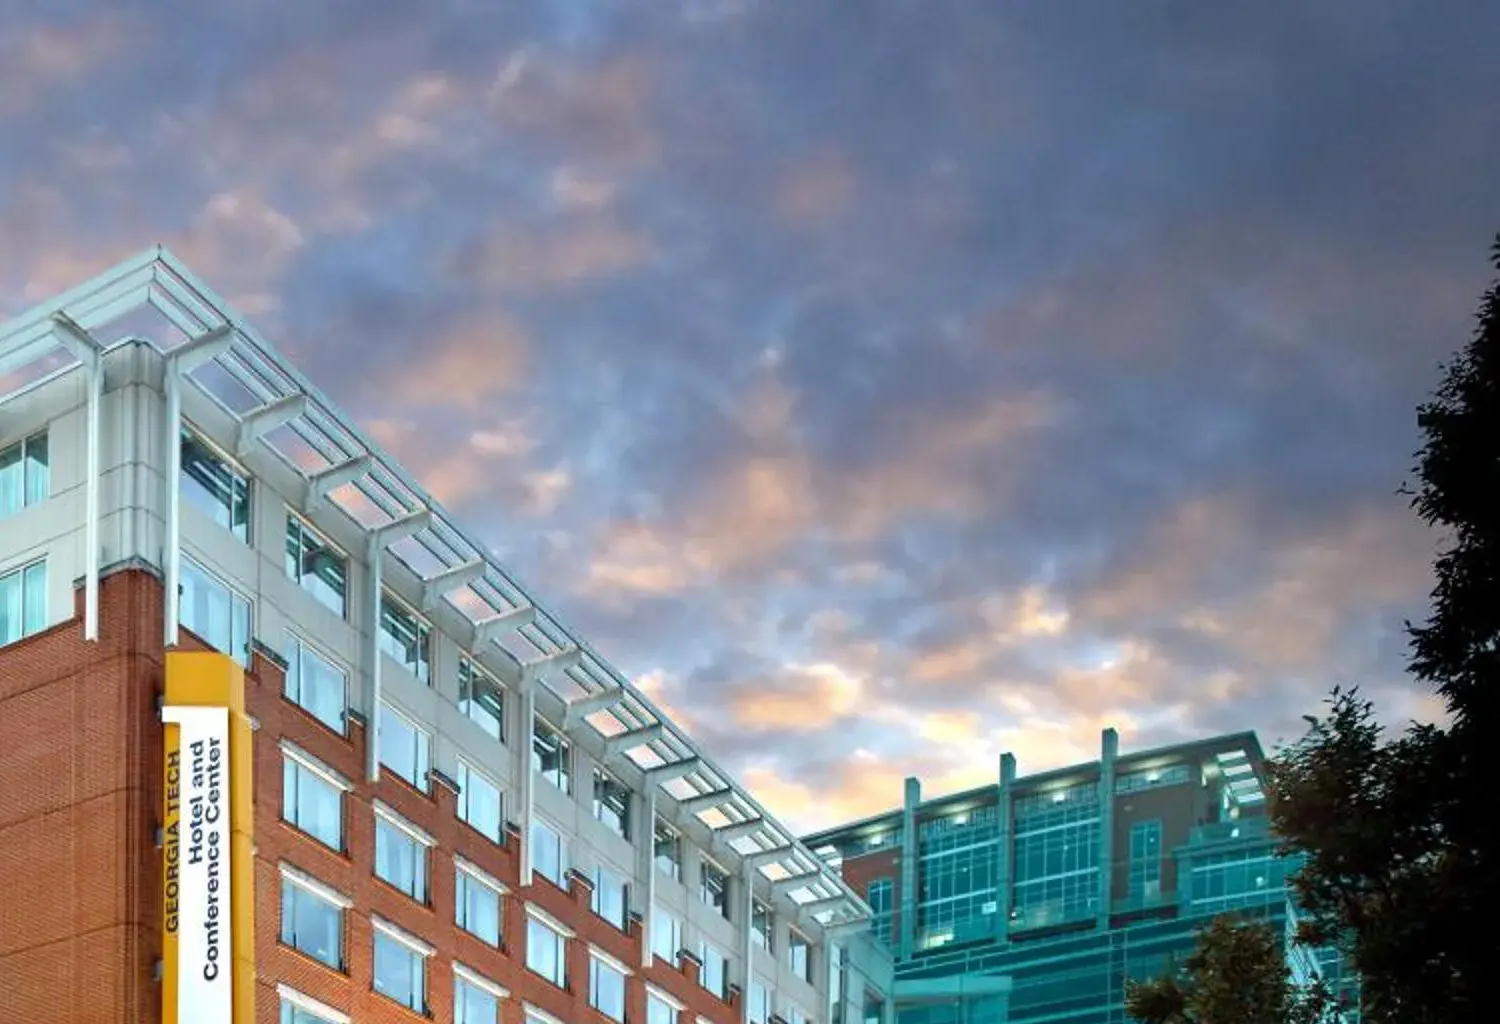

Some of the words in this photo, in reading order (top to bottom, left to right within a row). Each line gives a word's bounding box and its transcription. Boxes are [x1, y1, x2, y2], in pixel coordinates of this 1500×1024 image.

[167, 750, 180, 817] TECH
[190, 741, 204, 788] and
[206, 737, 220, 824] Center
[189, 796, 203, 865] Hotel
[165, 820, 180, 933] GEORGIA
[203, 831, 219, 982] Conference
